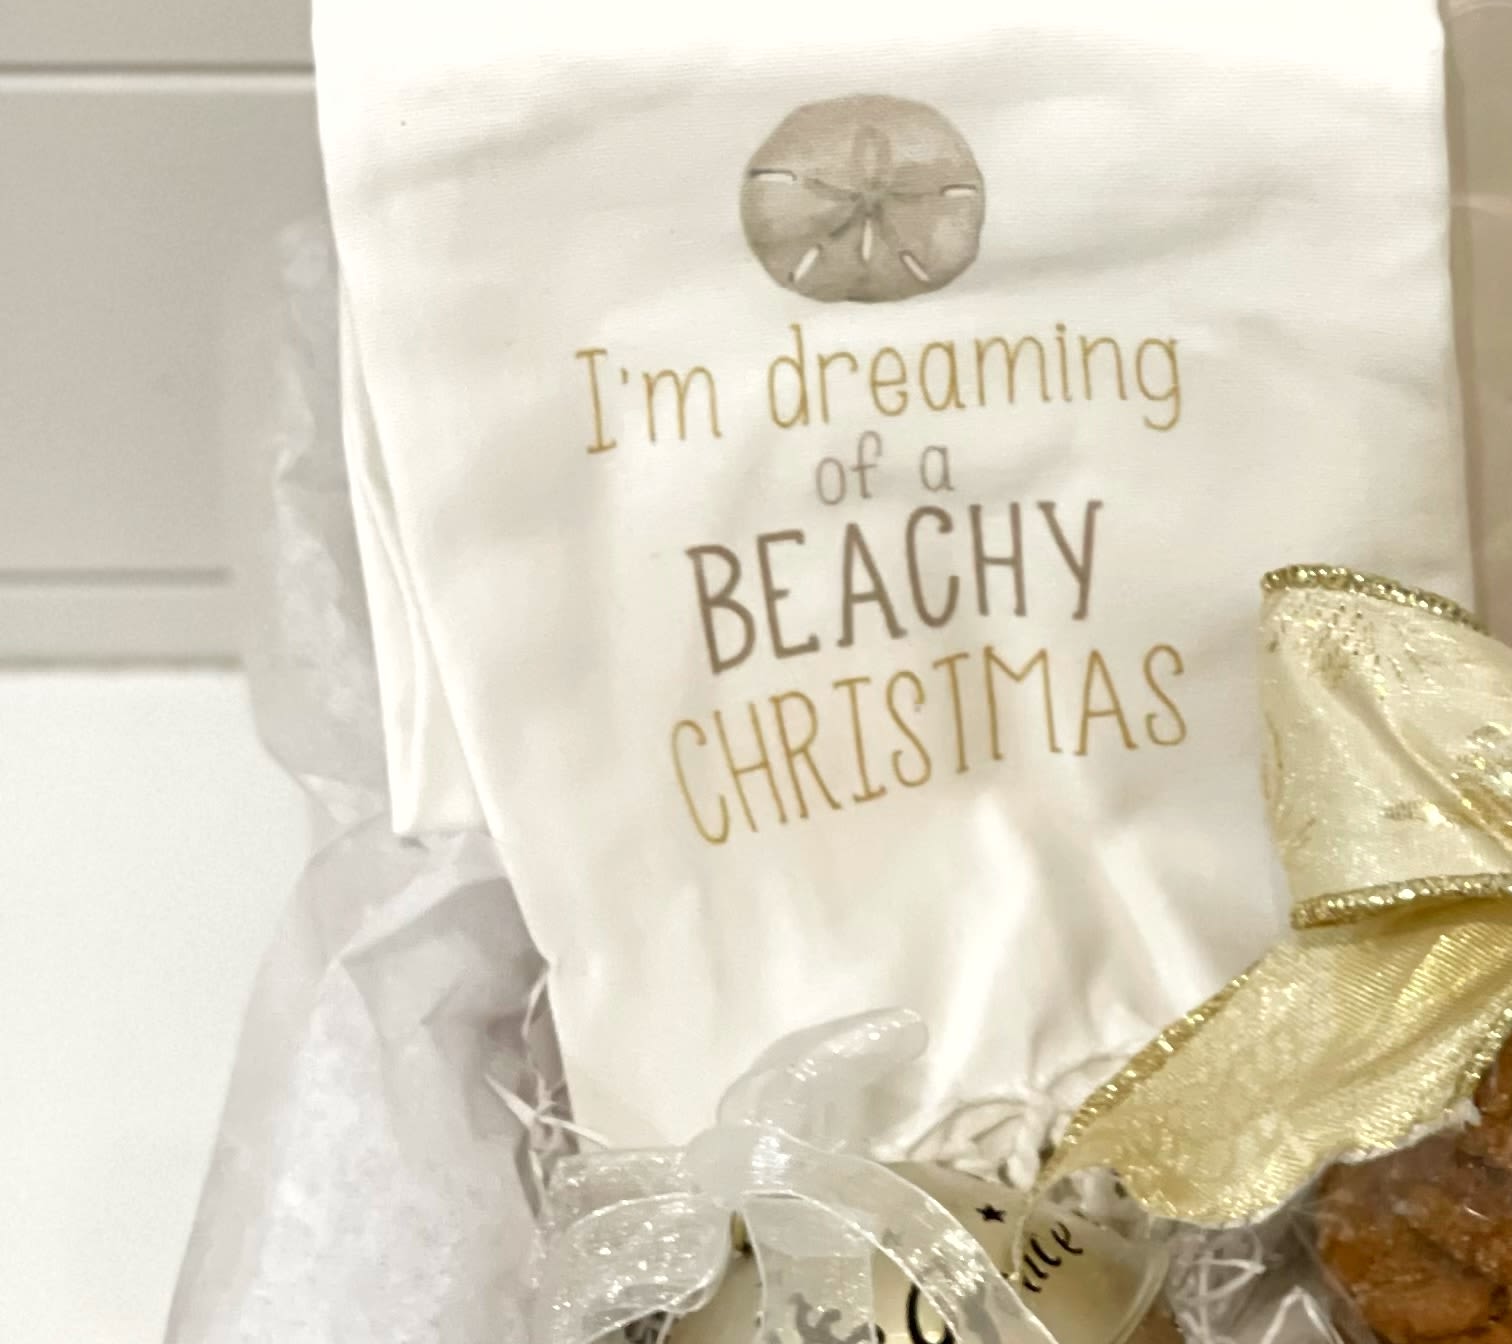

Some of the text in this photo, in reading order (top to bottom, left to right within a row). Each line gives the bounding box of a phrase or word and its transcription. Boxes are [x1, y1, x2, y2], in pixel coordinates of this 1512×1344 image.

[573, 321, 1183, 456] I'm dreaming
[815, 430, 956, 507] of a
[683, 499, 1104, 677] BEACHY
[670, 642, 1188, 847] CHRISTMAS
